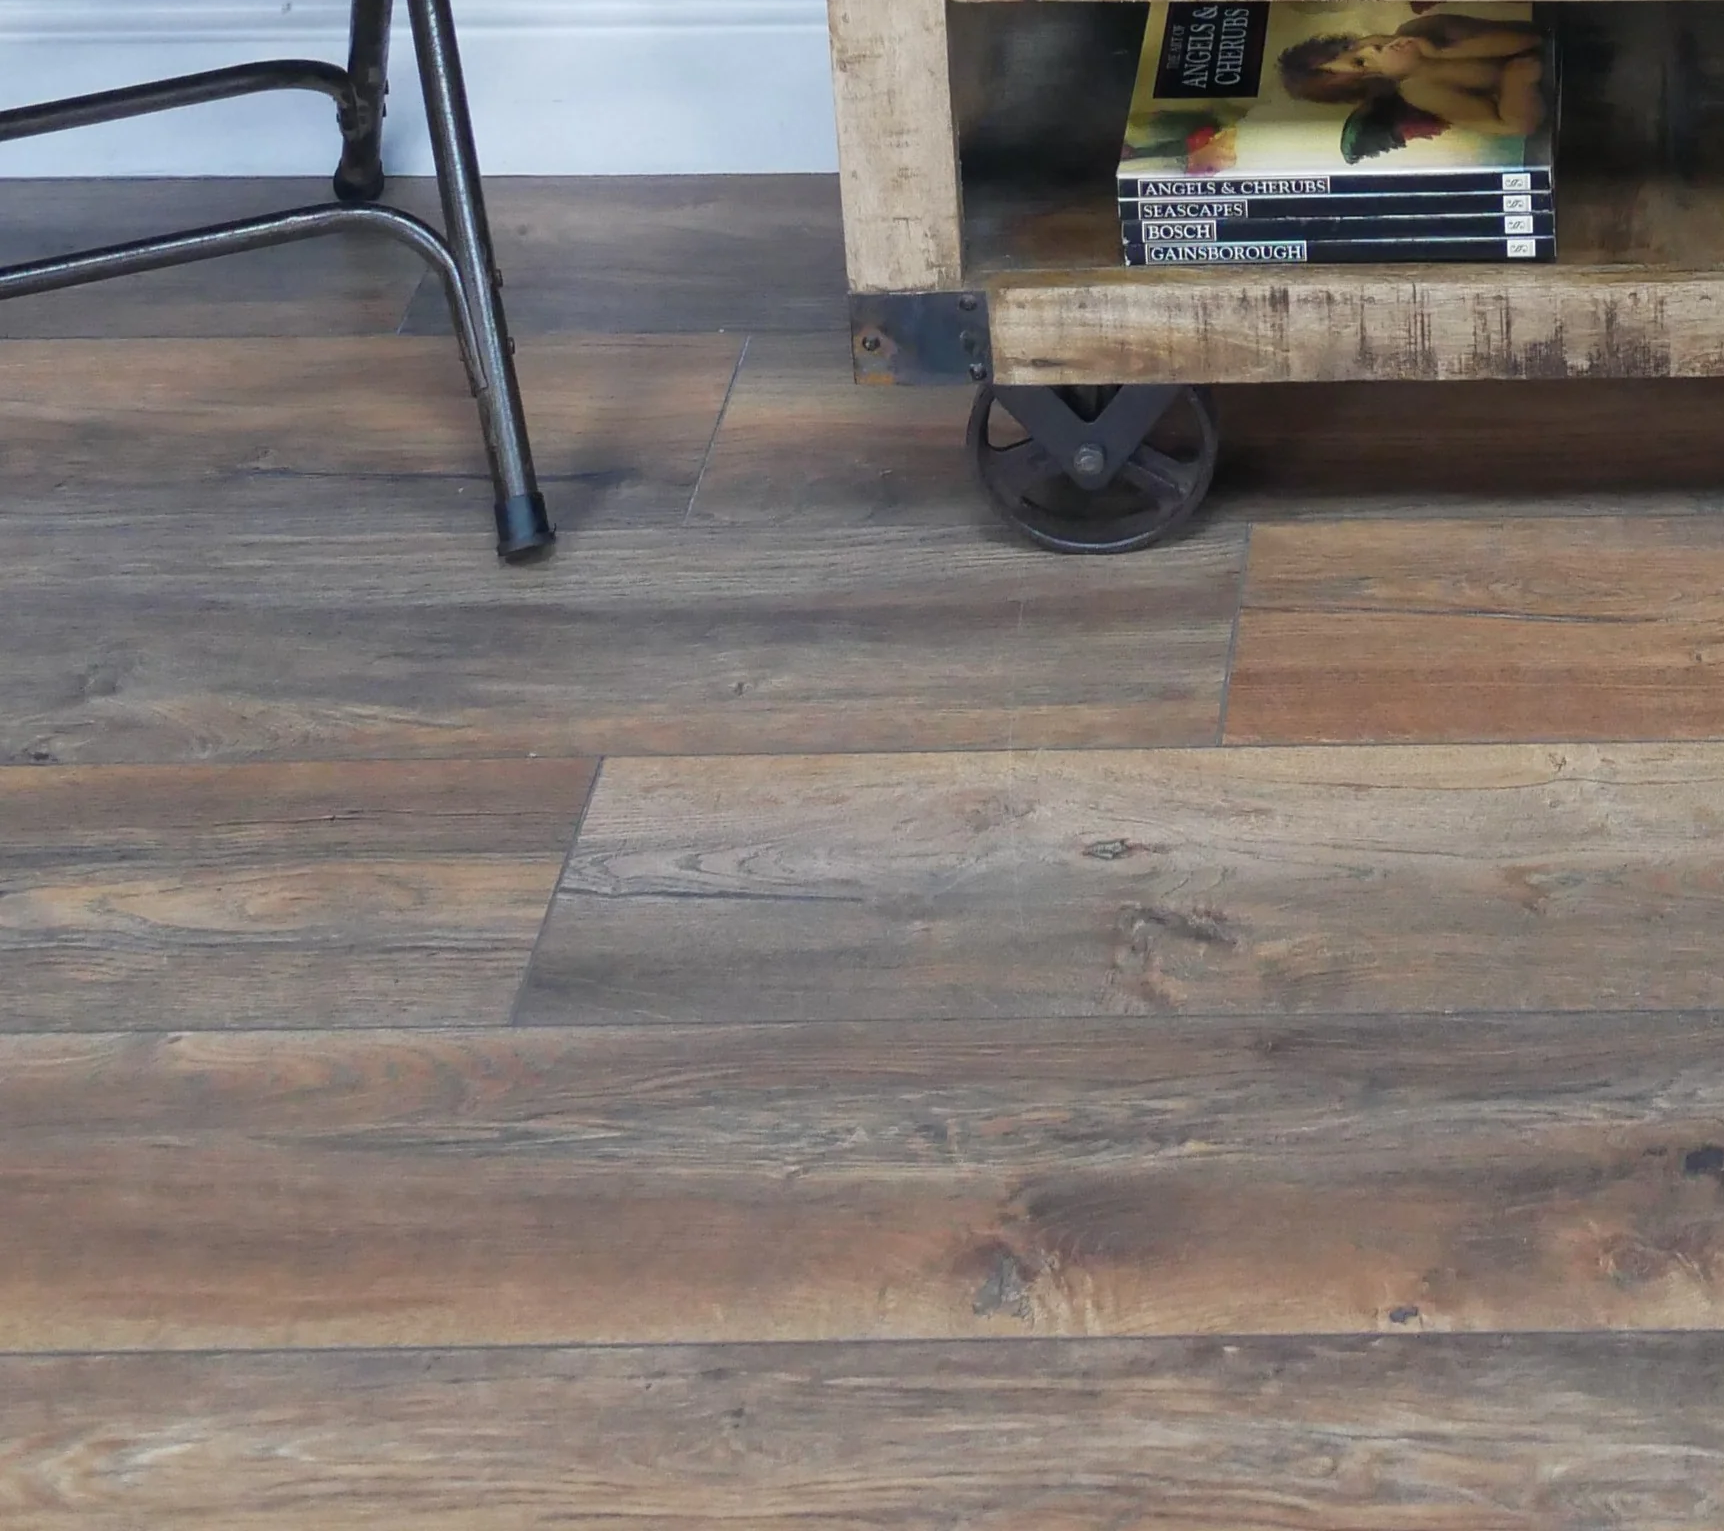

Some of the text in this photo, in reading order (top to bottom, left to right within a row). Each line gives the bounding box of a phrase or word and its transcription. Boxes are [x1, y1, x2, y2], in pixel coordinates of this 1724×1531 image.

[1181, 5, 1219, 89] ANGELS &
[1214, 8, 1250, 86] CHERUBS
[1145, 179, 1326, 196] ANGELS & CHERUBS
[1143, 203, 1243, 218] SEASCAPES
[1148, 224, 1211, 239] BOSCH
[1151, 245, 1302, 261] GAINSBOROUGH
